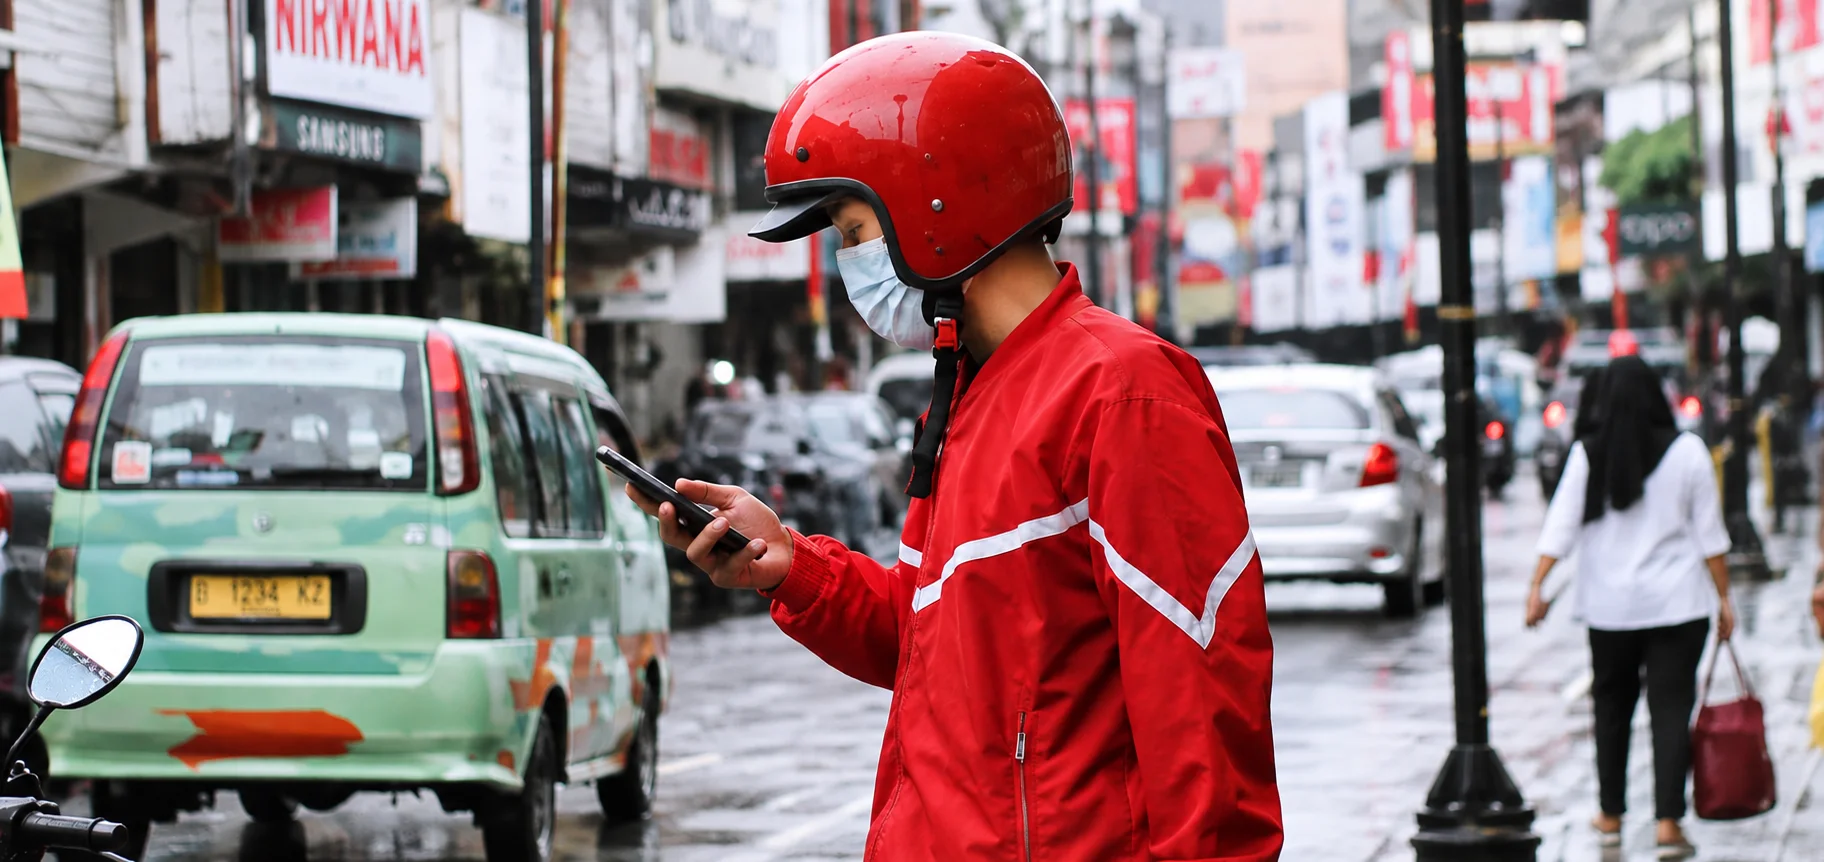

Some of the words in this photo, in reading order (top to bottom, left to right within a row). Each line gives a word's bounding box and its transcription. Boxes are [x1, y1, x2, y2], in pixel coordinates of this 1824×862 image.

[273, 0, 426, 77] NIRWANA
[296, 113, 386, 162] SAMSUNG
[231, 577, 279, 606] 1234
